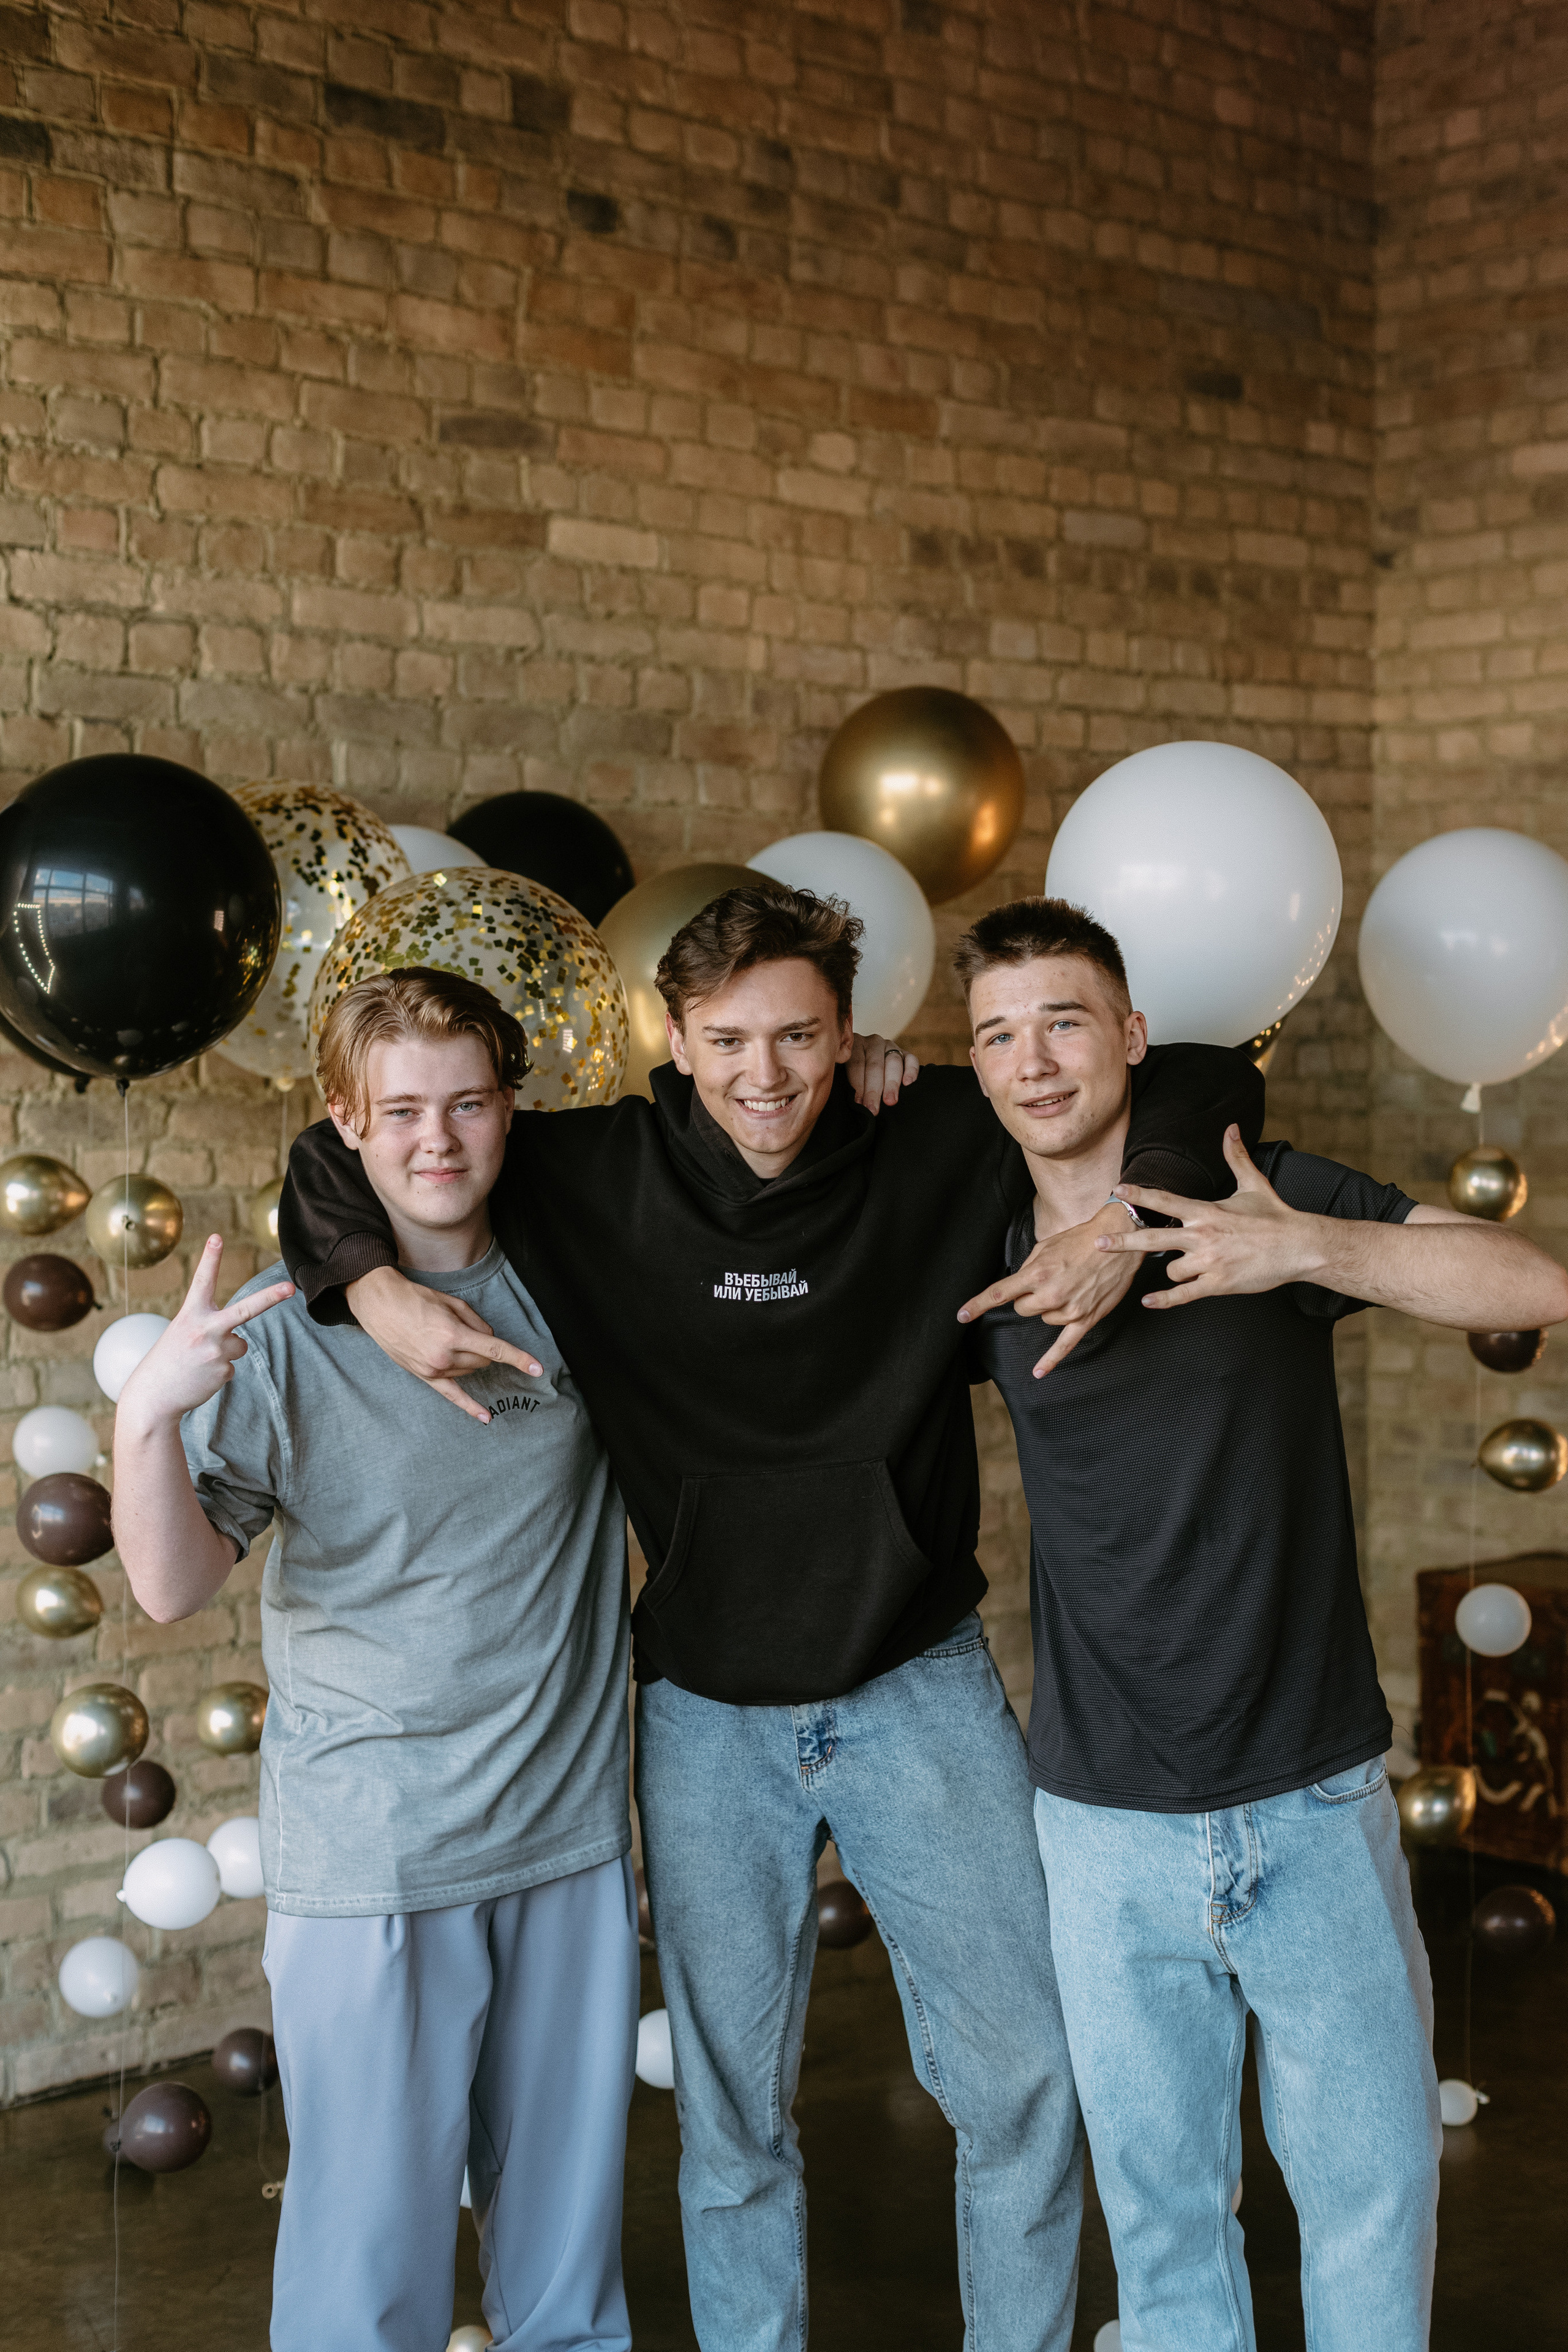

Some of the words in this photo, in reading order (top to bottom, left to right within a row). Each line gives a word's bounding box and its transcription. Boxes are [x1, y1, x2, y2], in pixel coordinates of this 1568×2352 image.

[725, 1268, 796, 1287] ВЪЕБЫВАЙ
[714, 1285, 741, 1300] ИЛИ
[745, 1280, 809, 1302] УЕБЫВАЙ
[483, 1396, 540, 1425] ADIANT
